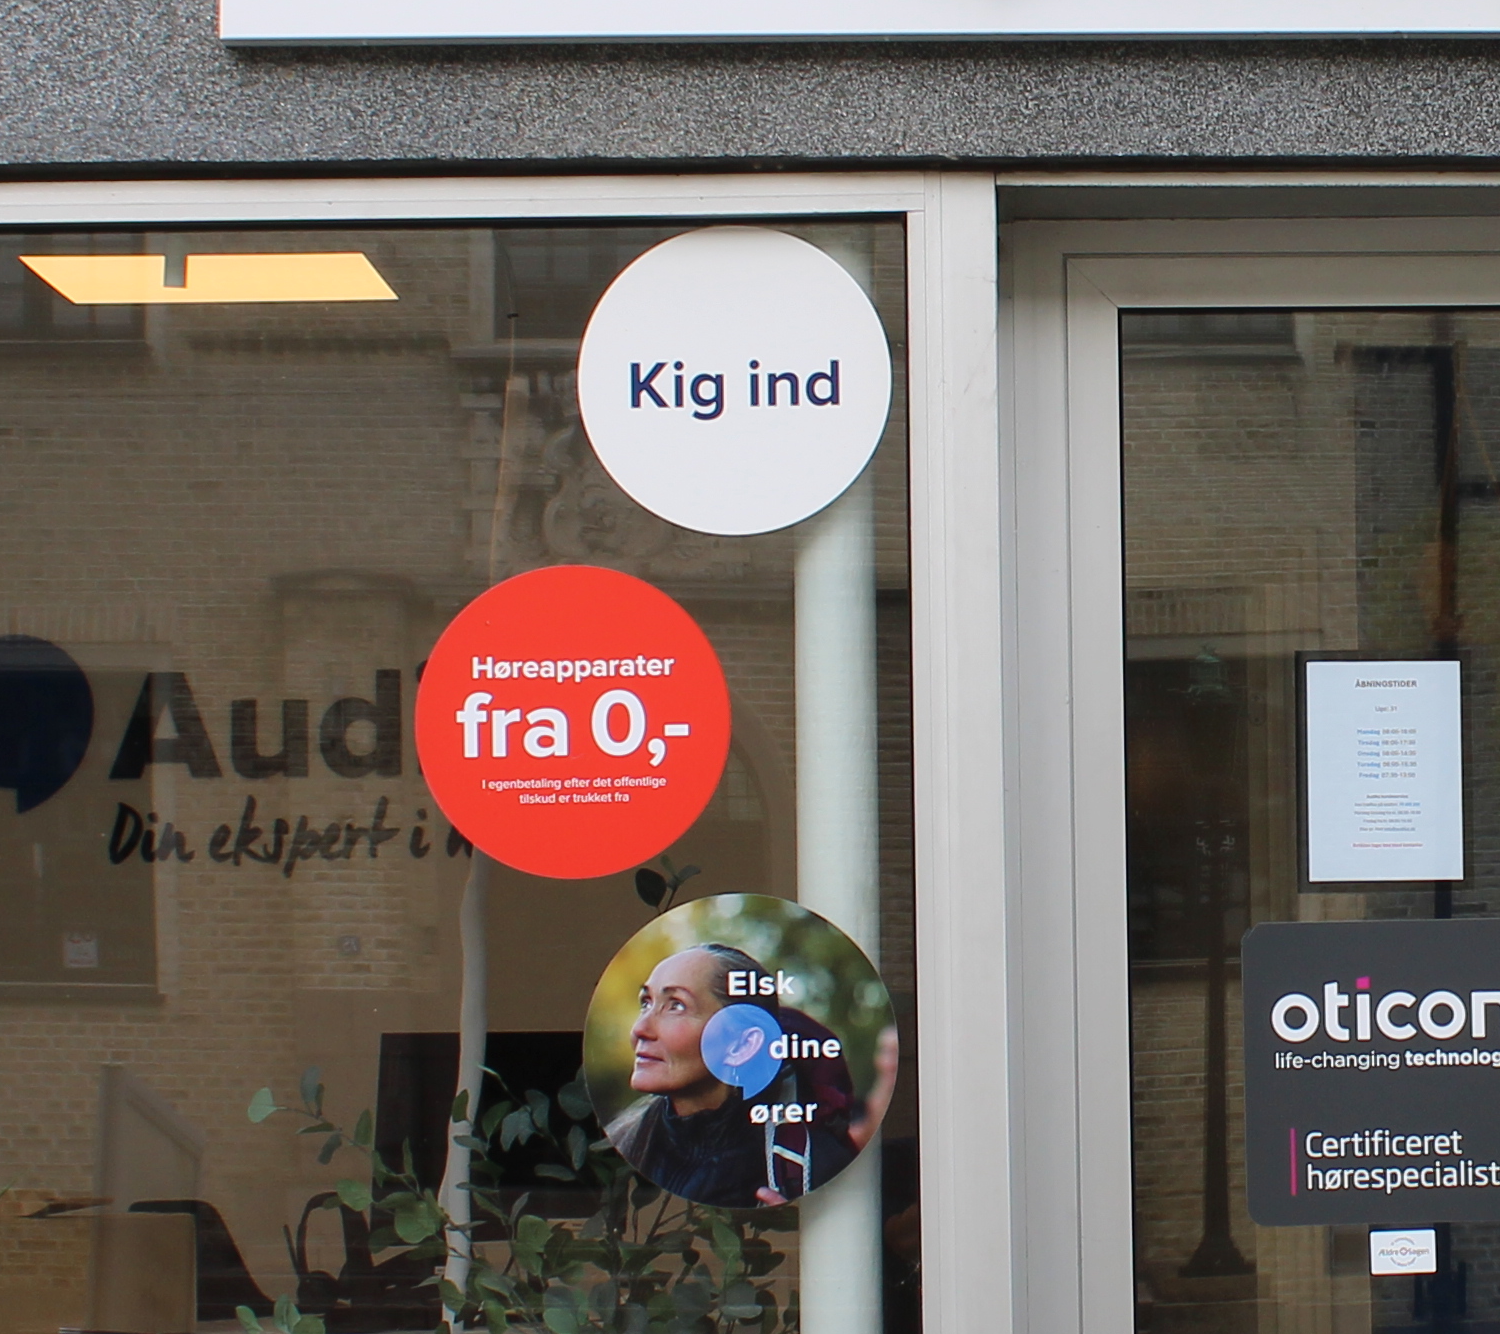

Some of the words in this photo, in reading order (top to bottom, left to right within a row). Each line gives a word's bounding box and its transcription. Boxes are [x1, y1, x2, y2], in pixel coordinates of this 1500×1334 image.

[630, 361, 725, 420] Kig
[749, 359, 841, 407] ind
[471, 654, 676, 684] Høreapparater
[1355, 679, 1417, 687] ÅBNINGSTIDER
[455, 692, 570, 759] fra
[591, 689, 691, 767] 0,-
[488, 778, 562, 792] egenbetaling
[564, 777, 591, 789] efter
[593, 777, 612, 788] det
[614, 775, 667, 789] offentlige
[519, 793, 556, 805] tilskud
[558, 794, 571, 804] er
[573, 792, 612, 803] trukket
[614, 792, 630, 803] fra
[109, 801, 196, 865] Din
[208, 795, 399, 879] ekspert
[409, 808, 431, 860] i
[727, 970, 795, 996] Elsk
[769, 1033, 842, 1059] dine
[1275, 1051, 1400, 1070] life-changing
[750, 1102, 818, 1124] ører
[1305, 1130, 1463, 1158] Certificeret
[1306, 1161, 1500, 1194] hørespecialist
